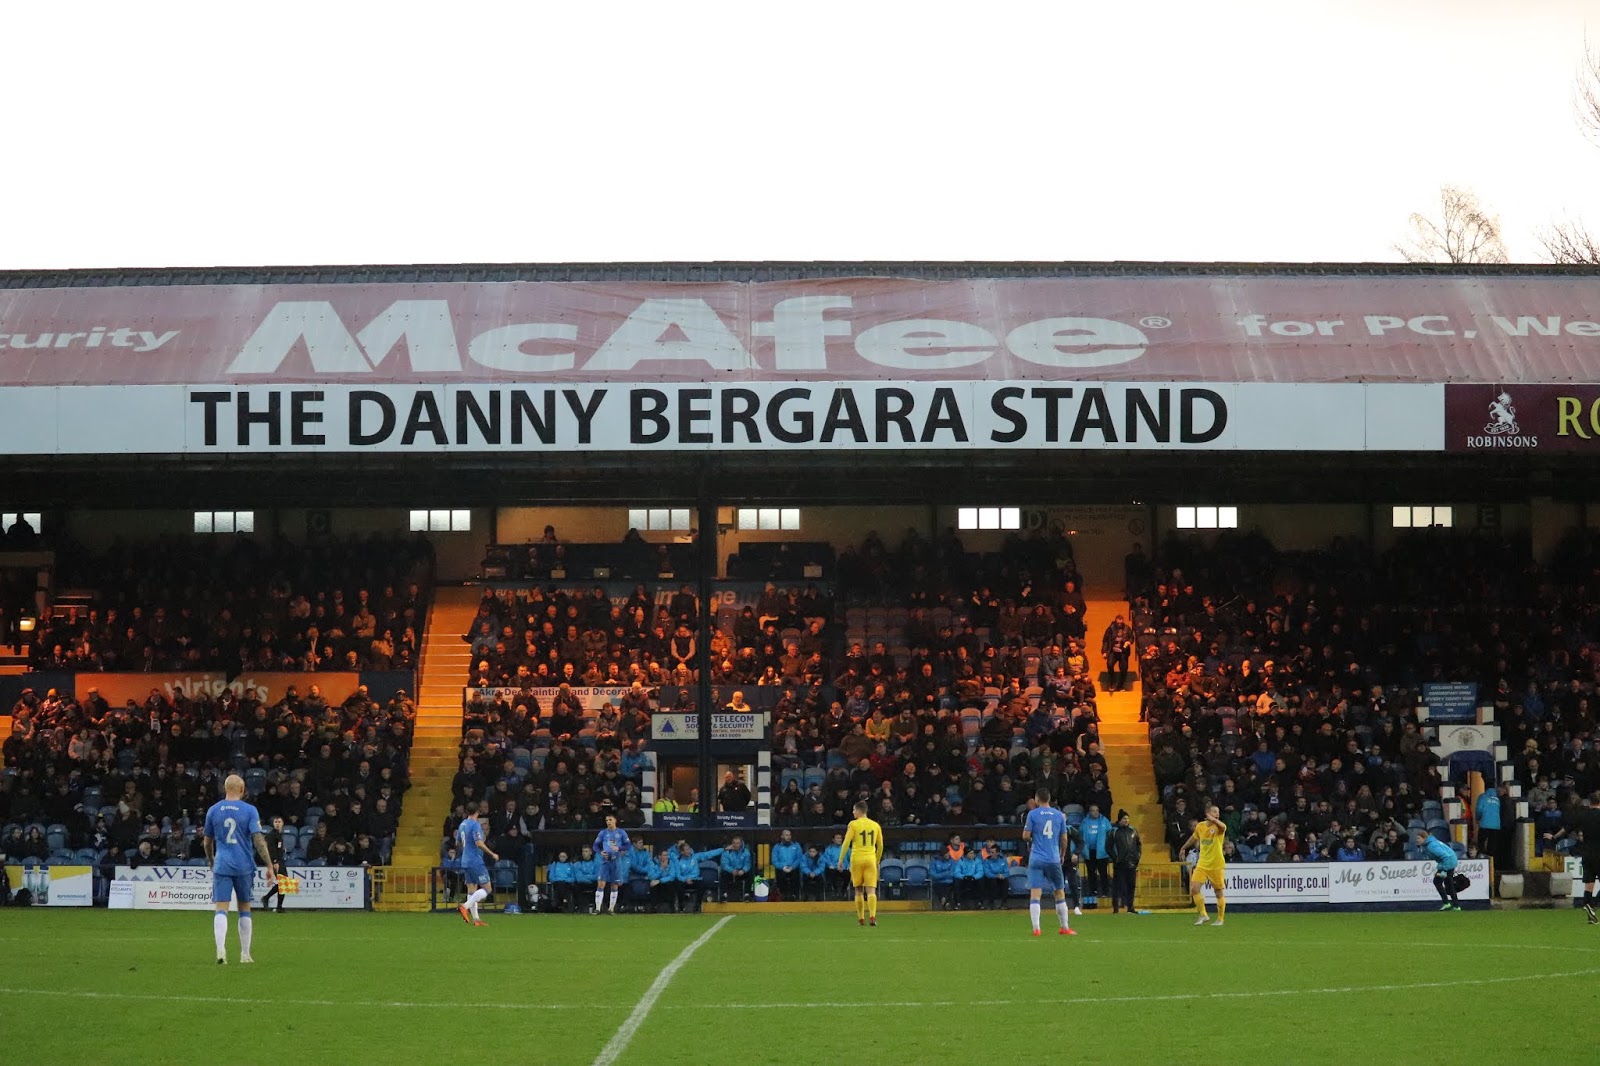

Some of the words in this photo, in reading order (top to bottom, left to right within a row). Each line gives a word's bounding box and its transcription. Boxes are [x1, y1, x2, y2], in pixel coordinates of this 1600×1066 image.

[1237, 314, 1344, 337] for
[190, 391, 326, 446] THE
[349, 390, 608, 446] DANNY
[629, 387, 968, 444] BERGARA
[991, 386, 1228, 443] STAND
[1467, 436, 1537, 447] ROBINSONS
[713, 715, 754, 723] TELECOM
[224, 817, 238, 844] 2
[859, 830, 875, 846] 11
[1042, 820, 1054, 839] 4
[1335, 869, 1362, 887] My
[1366, 867, 1375, 881] 6
[1379, 865, 1417, 881] Sweet
[148, 890, 158, 898] M
